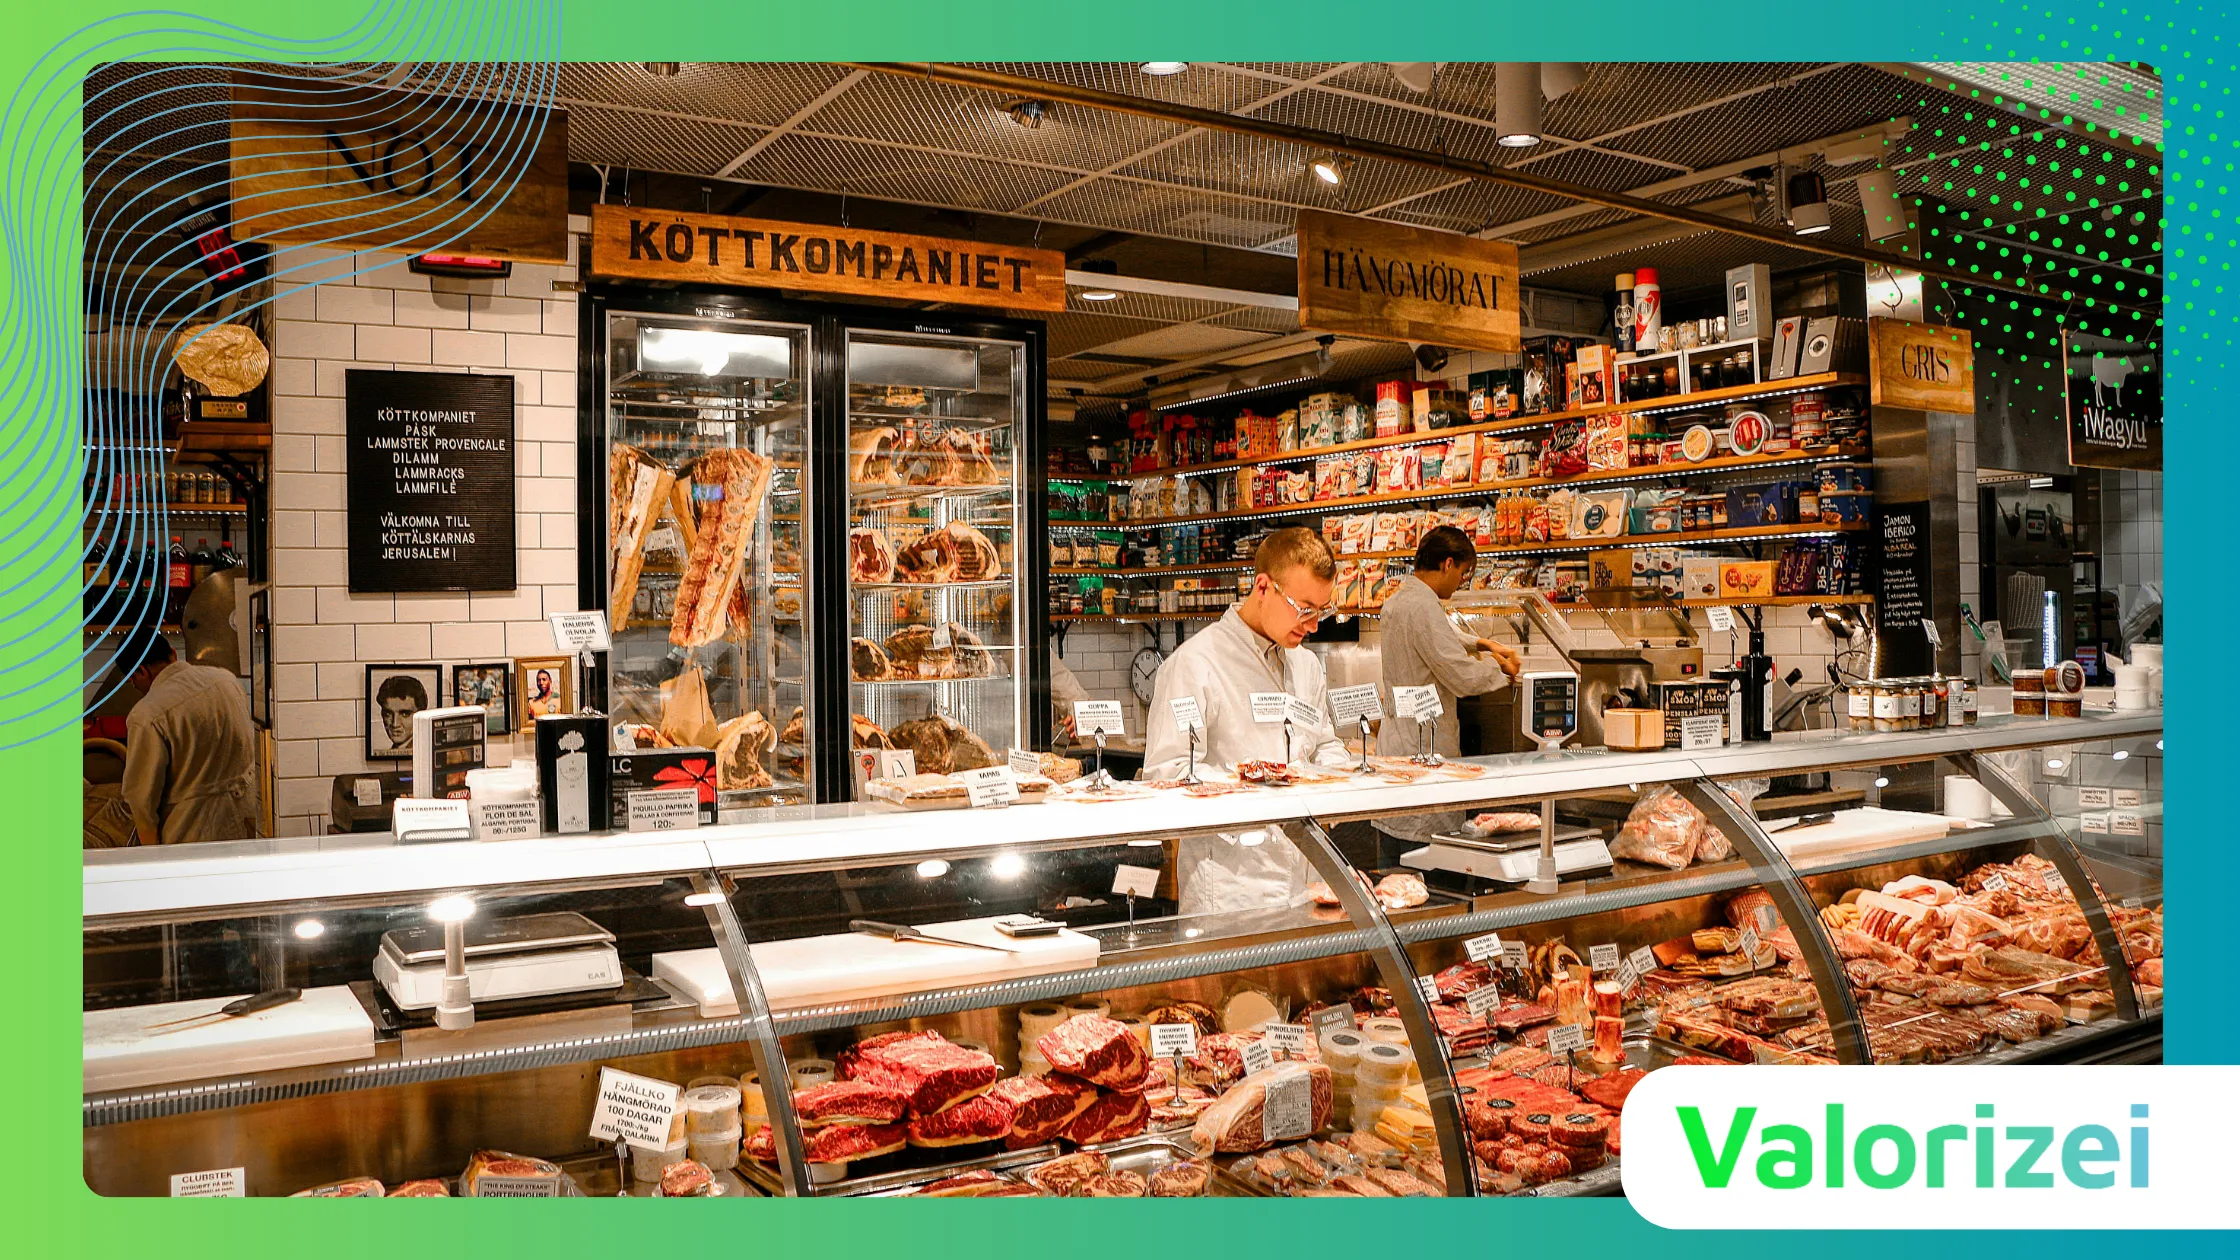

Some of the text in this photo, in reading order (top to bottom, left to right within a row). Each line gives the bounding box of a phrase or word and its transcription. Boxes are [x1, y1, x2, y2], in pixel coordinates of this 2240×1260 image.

[326, 128, 497, 201] NÖT
[629, 218, 1031, 293] KÖTTKOMPANIET
[1324, 247, 1504, 310] HÄNGMÖRAT
[1901, 342, 1950, 383] GRIS
[378, 407, 477, 423] KÖTTKOMPANIET
[2084, 406, 2146, 448] iWagyu
[367, 437, 506, 451] LAMMSTEK PROVENCALE
[393, 452, 439, 464] DILAMM
[395, 467, 465, 480] LAMMRACKS
[380, 511, 471, 528] VÄLKOMNA TILL
[382, 529, 477, 545] KÖTTÄLSKARNAS
[612, 757, 632, 774] LC
[615, 1081, 665, 1101] FJÄLLKO
[603, 1091, 672, 1114] HÄNGMÖRAD
[608, 1105, 663, 1125] 100 DAGAR
[625, 1129, 660, 1144] DALARNA
[182, 1171, 233, 1183] CLUBSTEK
